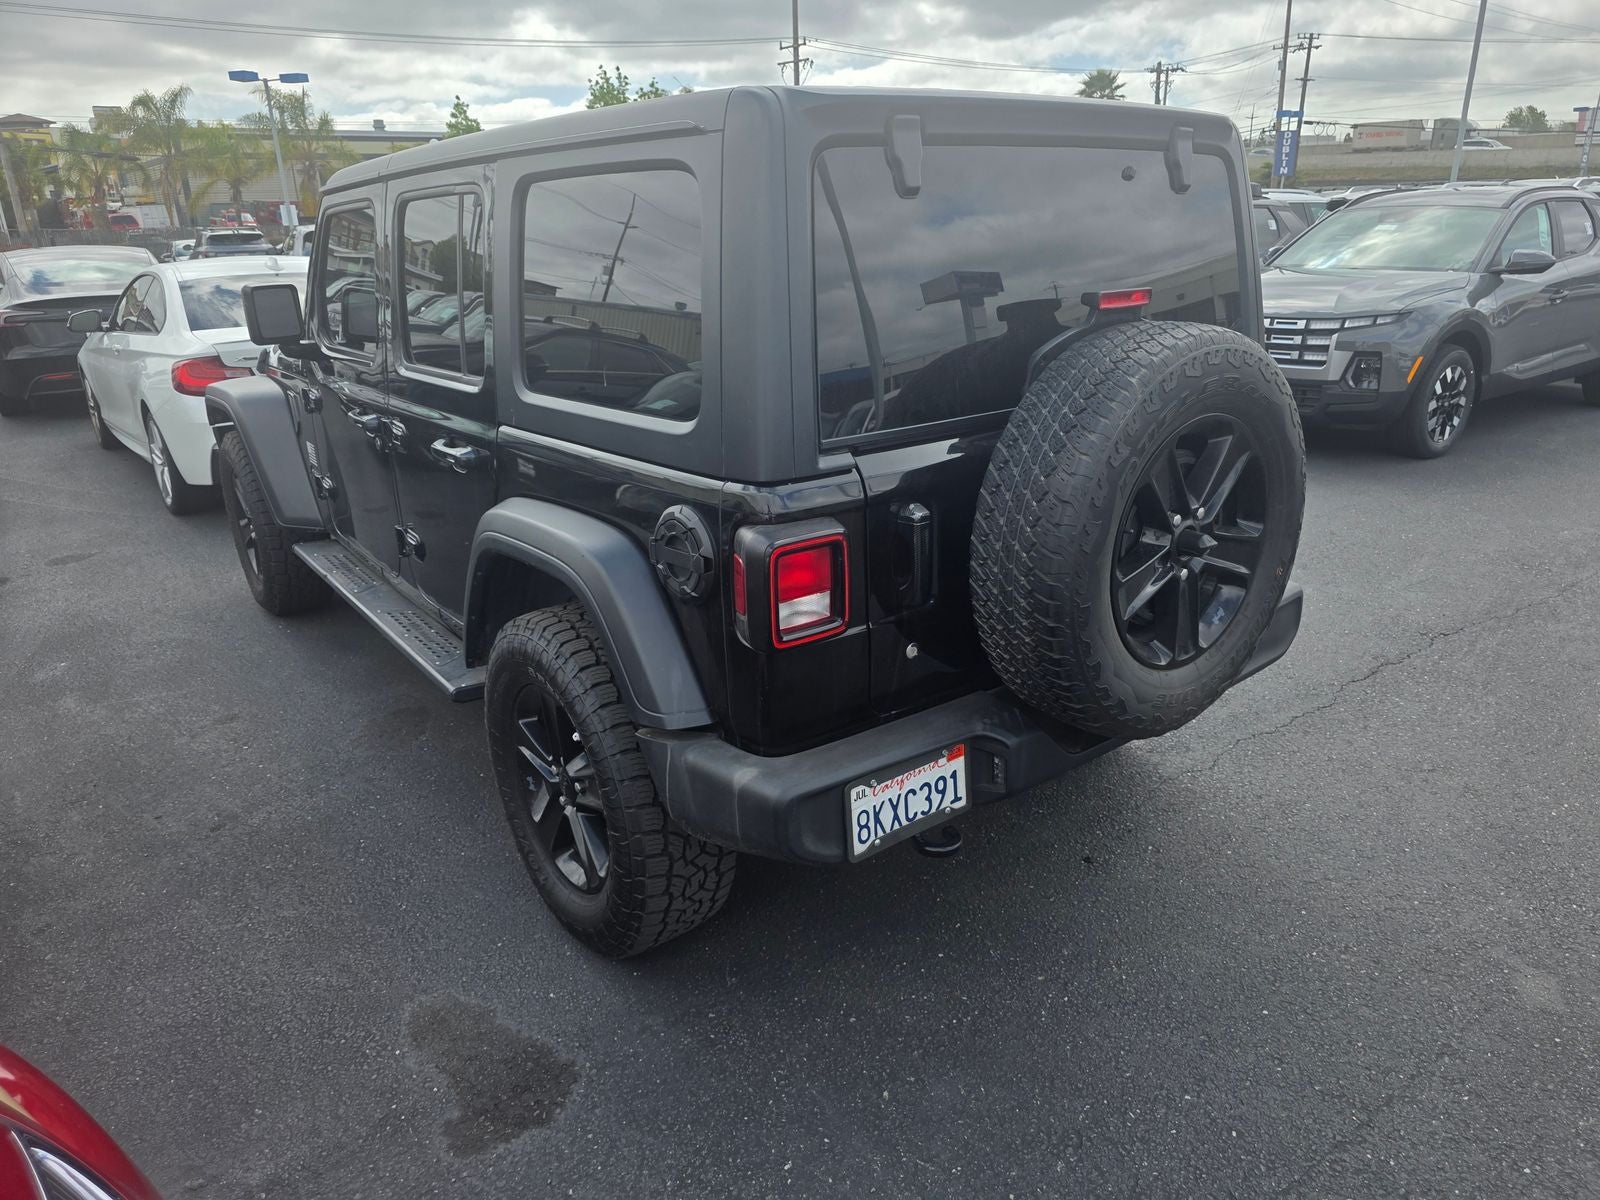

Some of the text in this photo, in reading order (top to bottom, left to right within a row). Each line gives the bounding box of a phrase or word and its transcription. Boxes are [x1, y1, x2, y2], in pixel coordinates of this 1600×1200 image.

[1279, 131, 1291, 175] DUBLIN
[853, 788, 868, 802] JUL
[870, 760, 947, 798] California
[857, 769, 963, 845] 8KXC391
